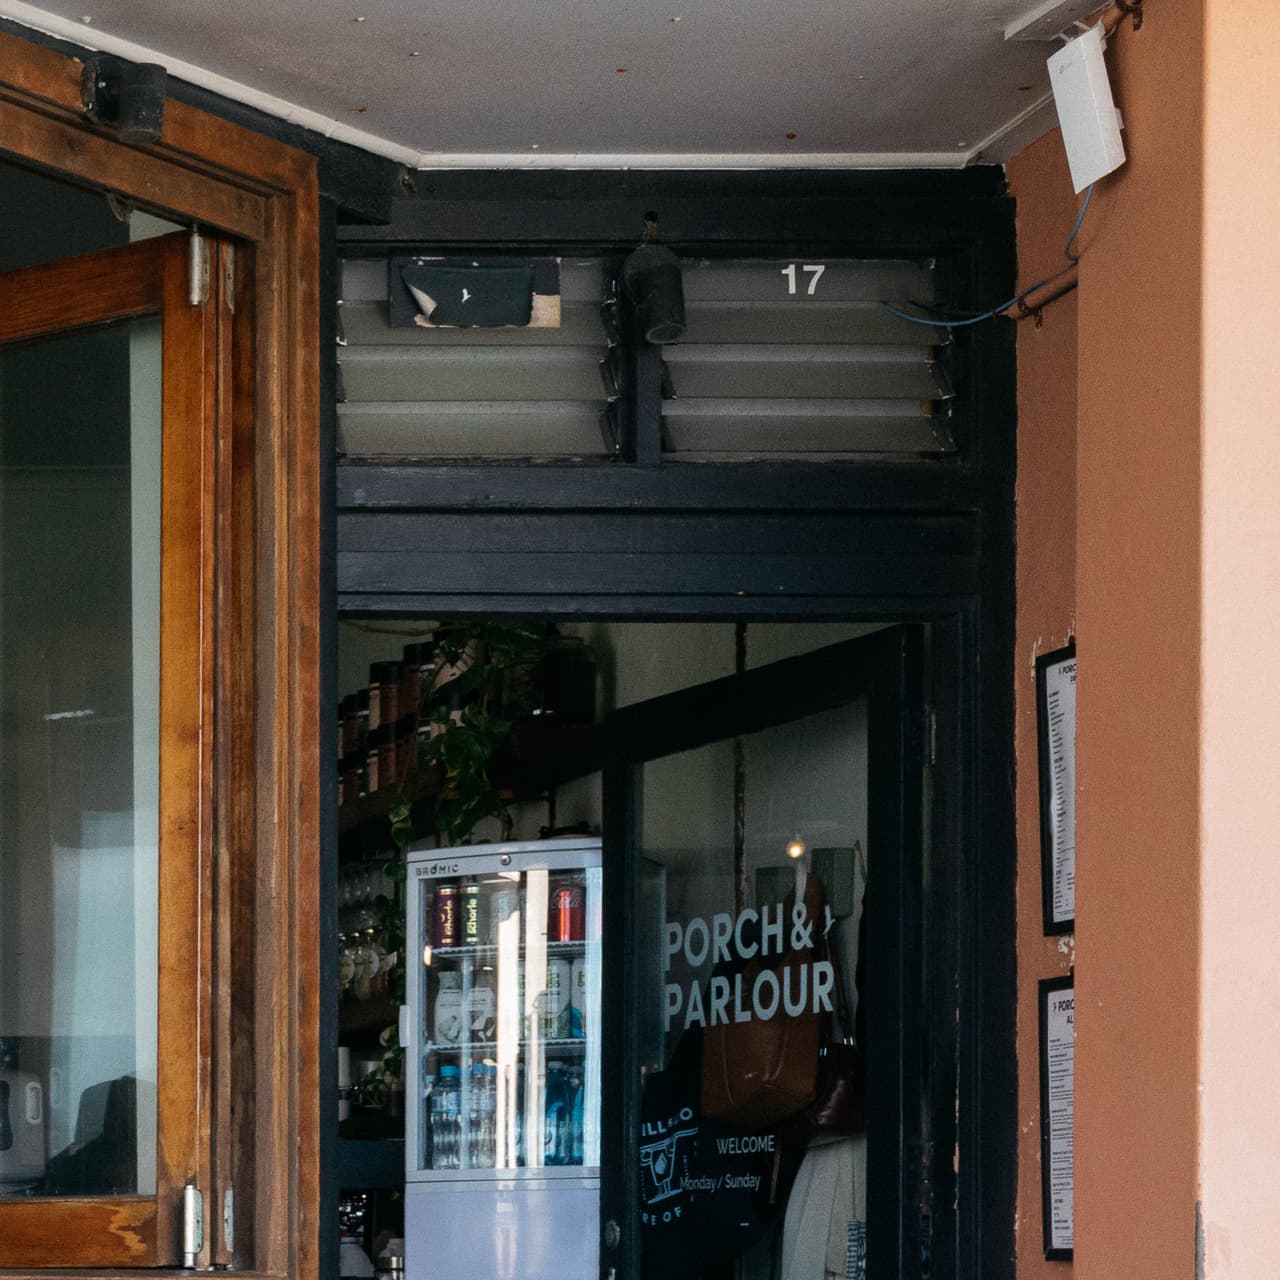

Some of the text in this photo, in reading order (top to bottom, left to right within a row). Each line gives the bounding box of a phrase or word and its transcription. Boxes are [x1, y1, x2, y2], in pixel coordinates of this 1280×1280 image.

[781, 264, 825, 295] 17
[416, 864, 459, 877] BROMIC
[665, 902, 814, 971] PORCH&
[664, 961, 834, 1032] PARLOUR
[716, 1135, 776, 1154] WELCOME
[680, 1175, 717, 1192] Monday
[725, 1172, 761, 1191] Sunday
